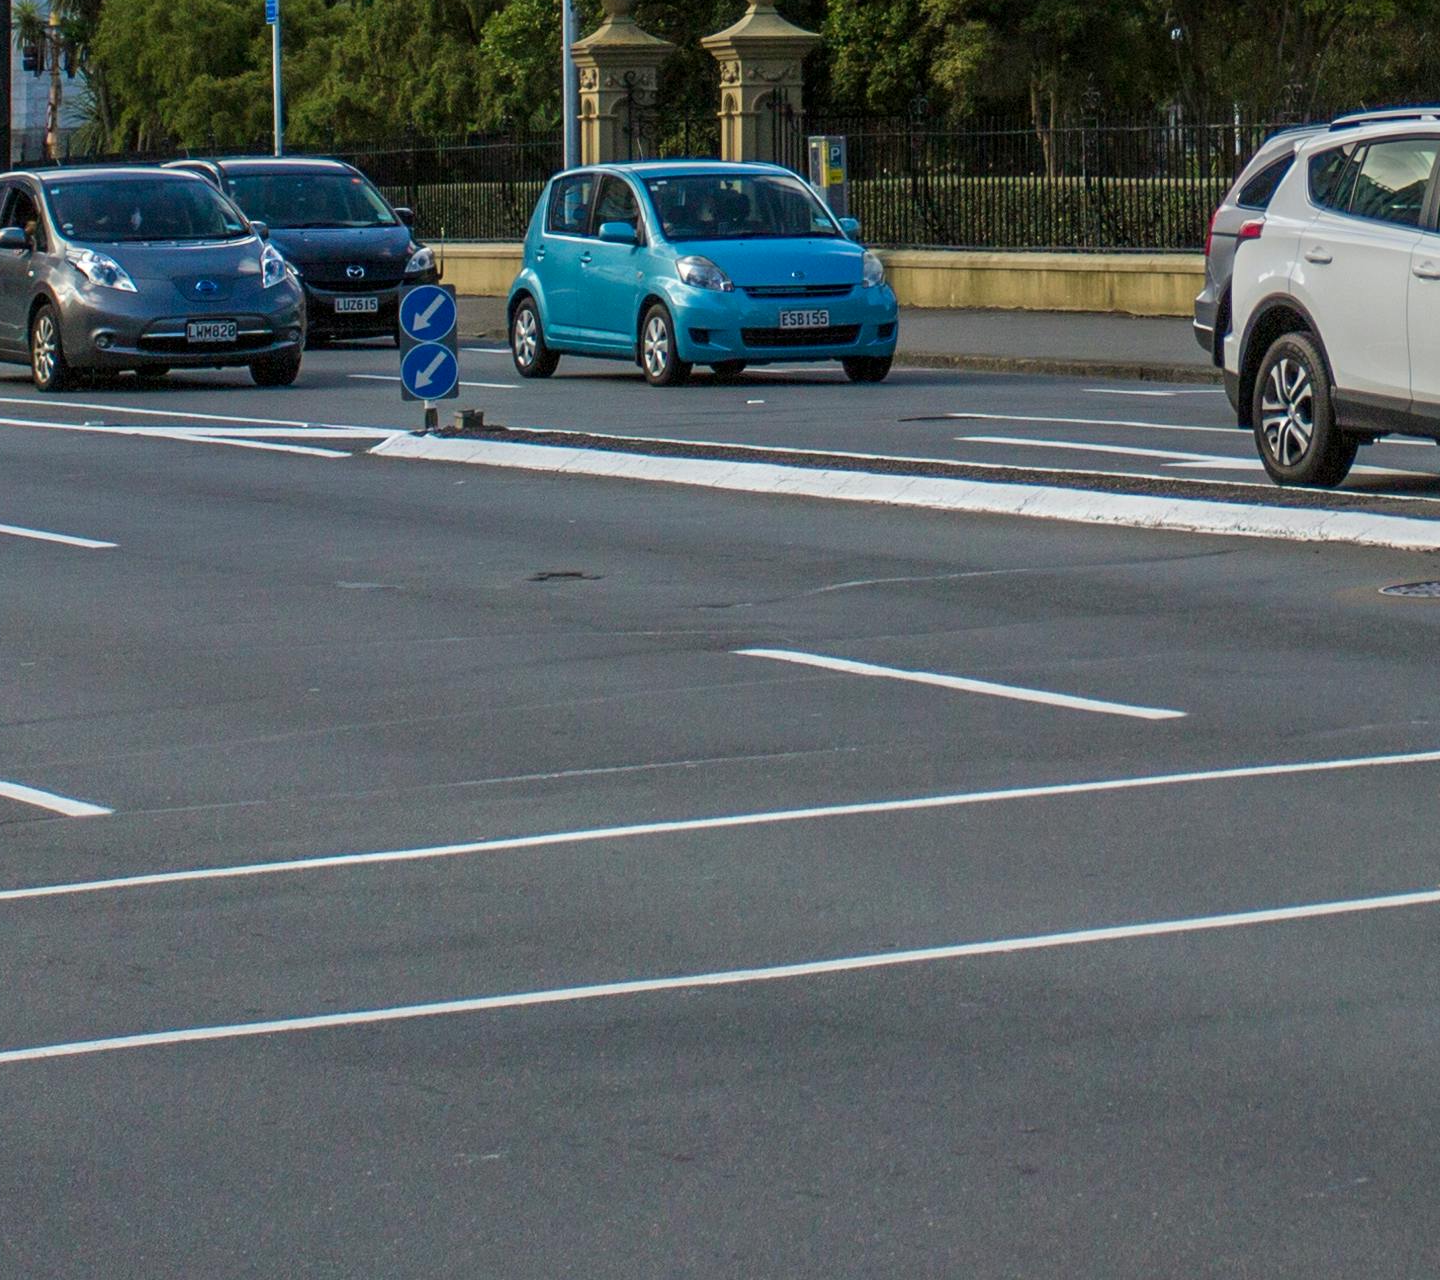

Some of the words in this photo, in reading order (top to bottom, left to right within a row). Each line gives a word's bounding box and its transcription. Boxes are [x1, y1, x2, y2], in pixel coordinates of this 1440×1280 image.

[831, 147, 840, 161] P
[336, 299, 377, 311] LUZ615
[782, 312, 827, 326] ESB155
